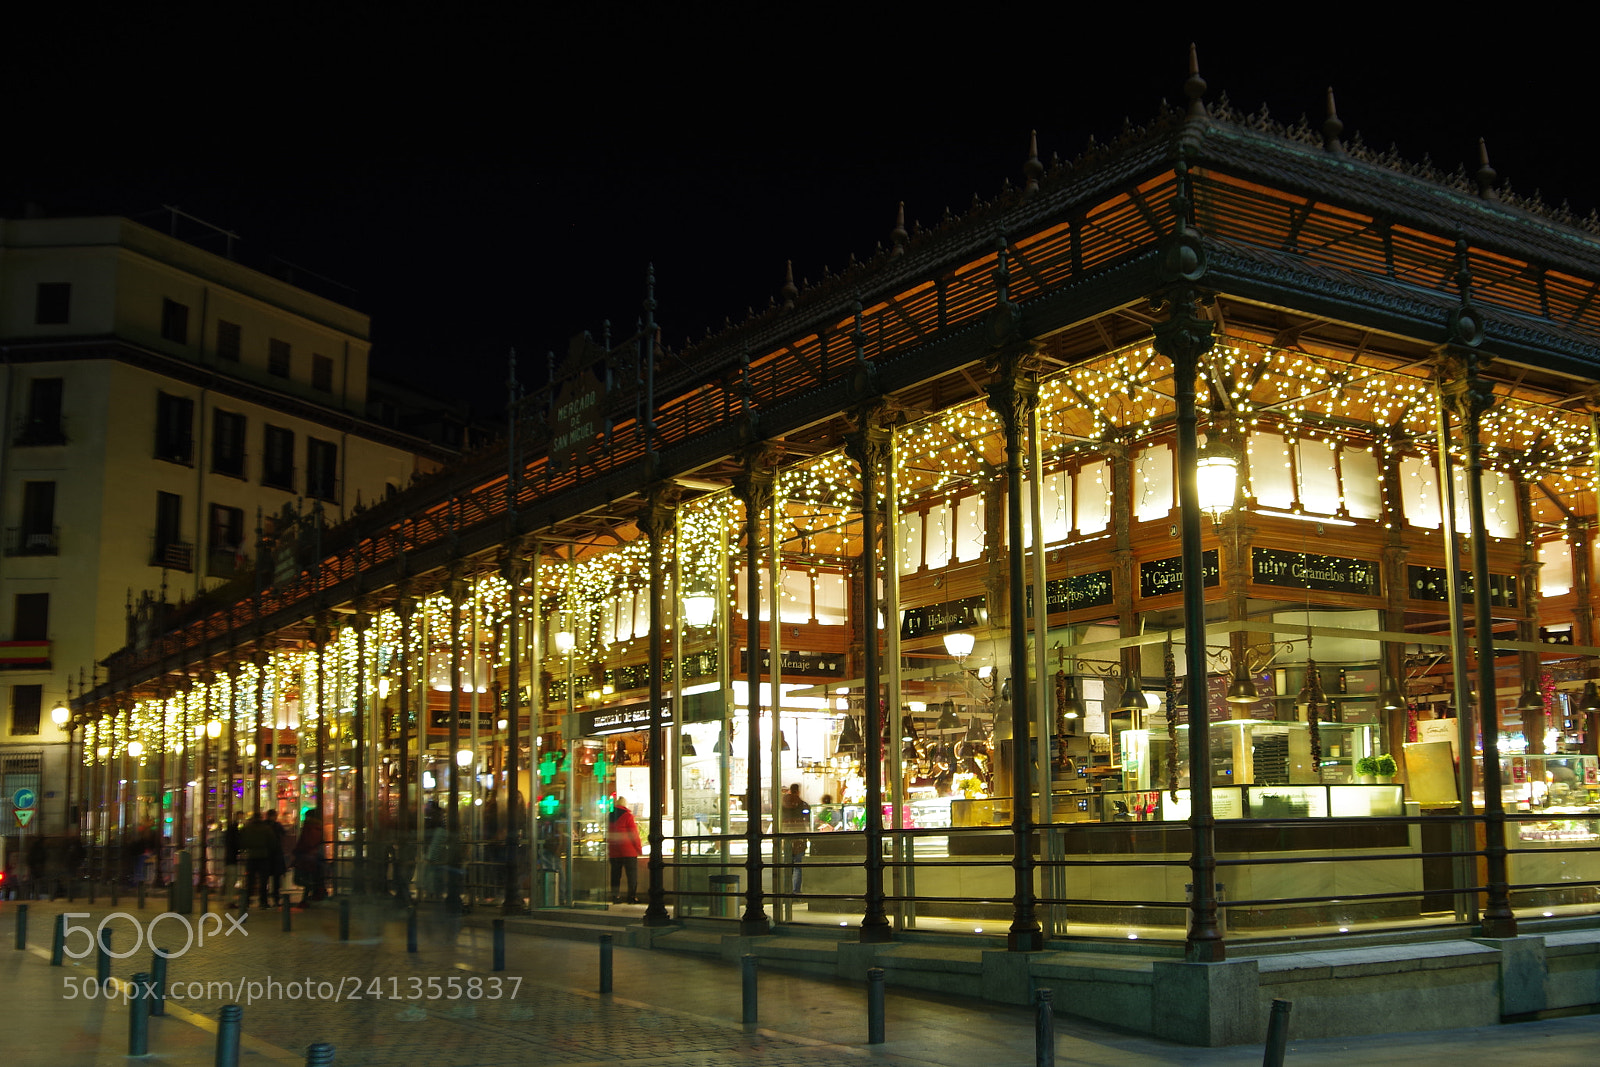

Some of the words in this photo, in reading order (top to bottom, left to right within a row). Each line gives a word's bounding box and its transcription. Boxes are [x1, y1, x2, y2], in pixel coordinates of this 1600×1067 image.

[557, 390, 596, 422] MERCADO
[570, 414, 581, 427] DE
[553, 433, 569, 452] SAN
[569, 421, 595, 445] MIGUEL
[1153, 567, 1208, 586] Carams
[1291, 563, 1345, 584] Caramelos
[928, 613, 958, 627] Helados
